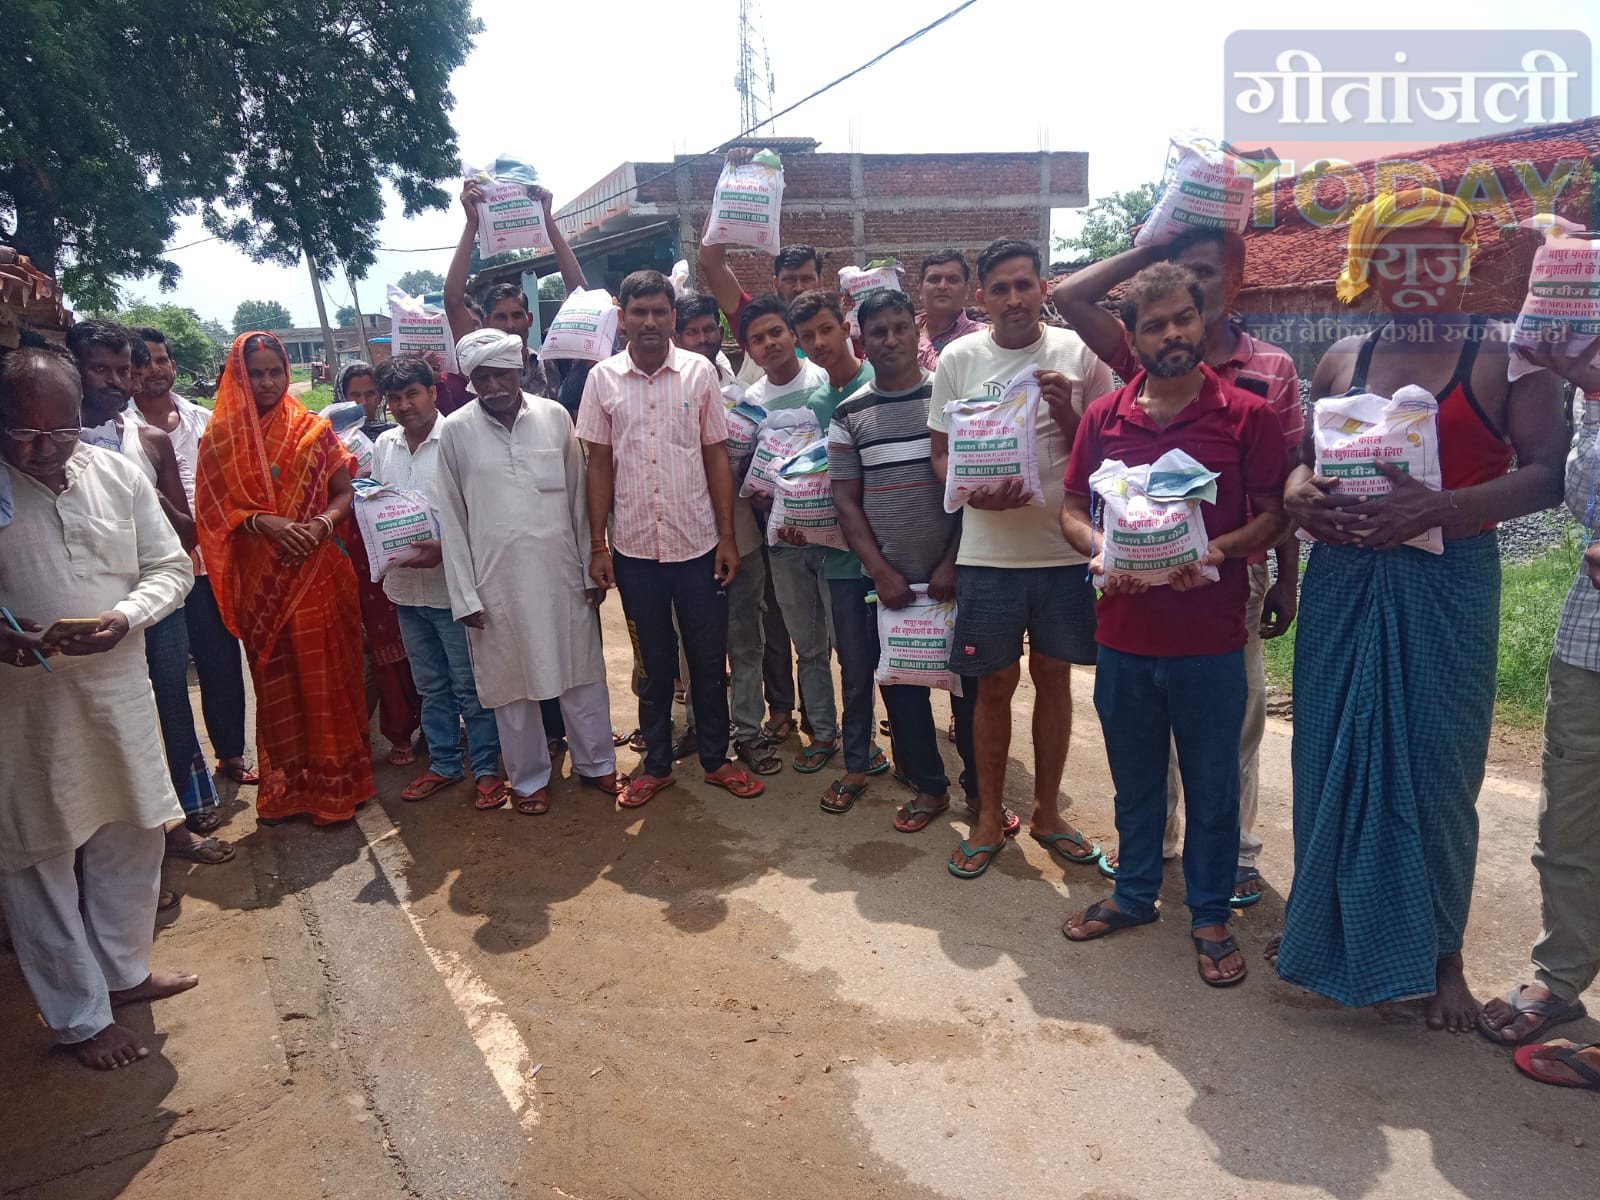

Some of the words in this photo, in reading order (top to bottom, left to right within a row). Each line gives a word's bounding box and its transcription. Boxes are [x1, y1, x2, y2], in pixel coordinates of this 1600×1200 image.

[1585, 263, 1597, 274] के
[1358, 436, 1382, 445] फसल
[1335, 447, 1370, 461] खुशहाली
[1373, 447, 1382, 457] के
[1385, 446, 1403, 457] लिए
[968, 466, 995, 474] QUALITY
[997, 465, 1017, 473] SEEDS
[1351, 466, 1376, 476] बीज
[395, 536, 416, 546] QUALITY
[1143, 535, 1166, 544] बीज
[1133, 546, 1161, 554] BUMPER
[1116, 560, 1130, 568] USE
[1133, 559, 1167, 569] QUALITY
[1170, 553, 1194, 565] SEEDS
